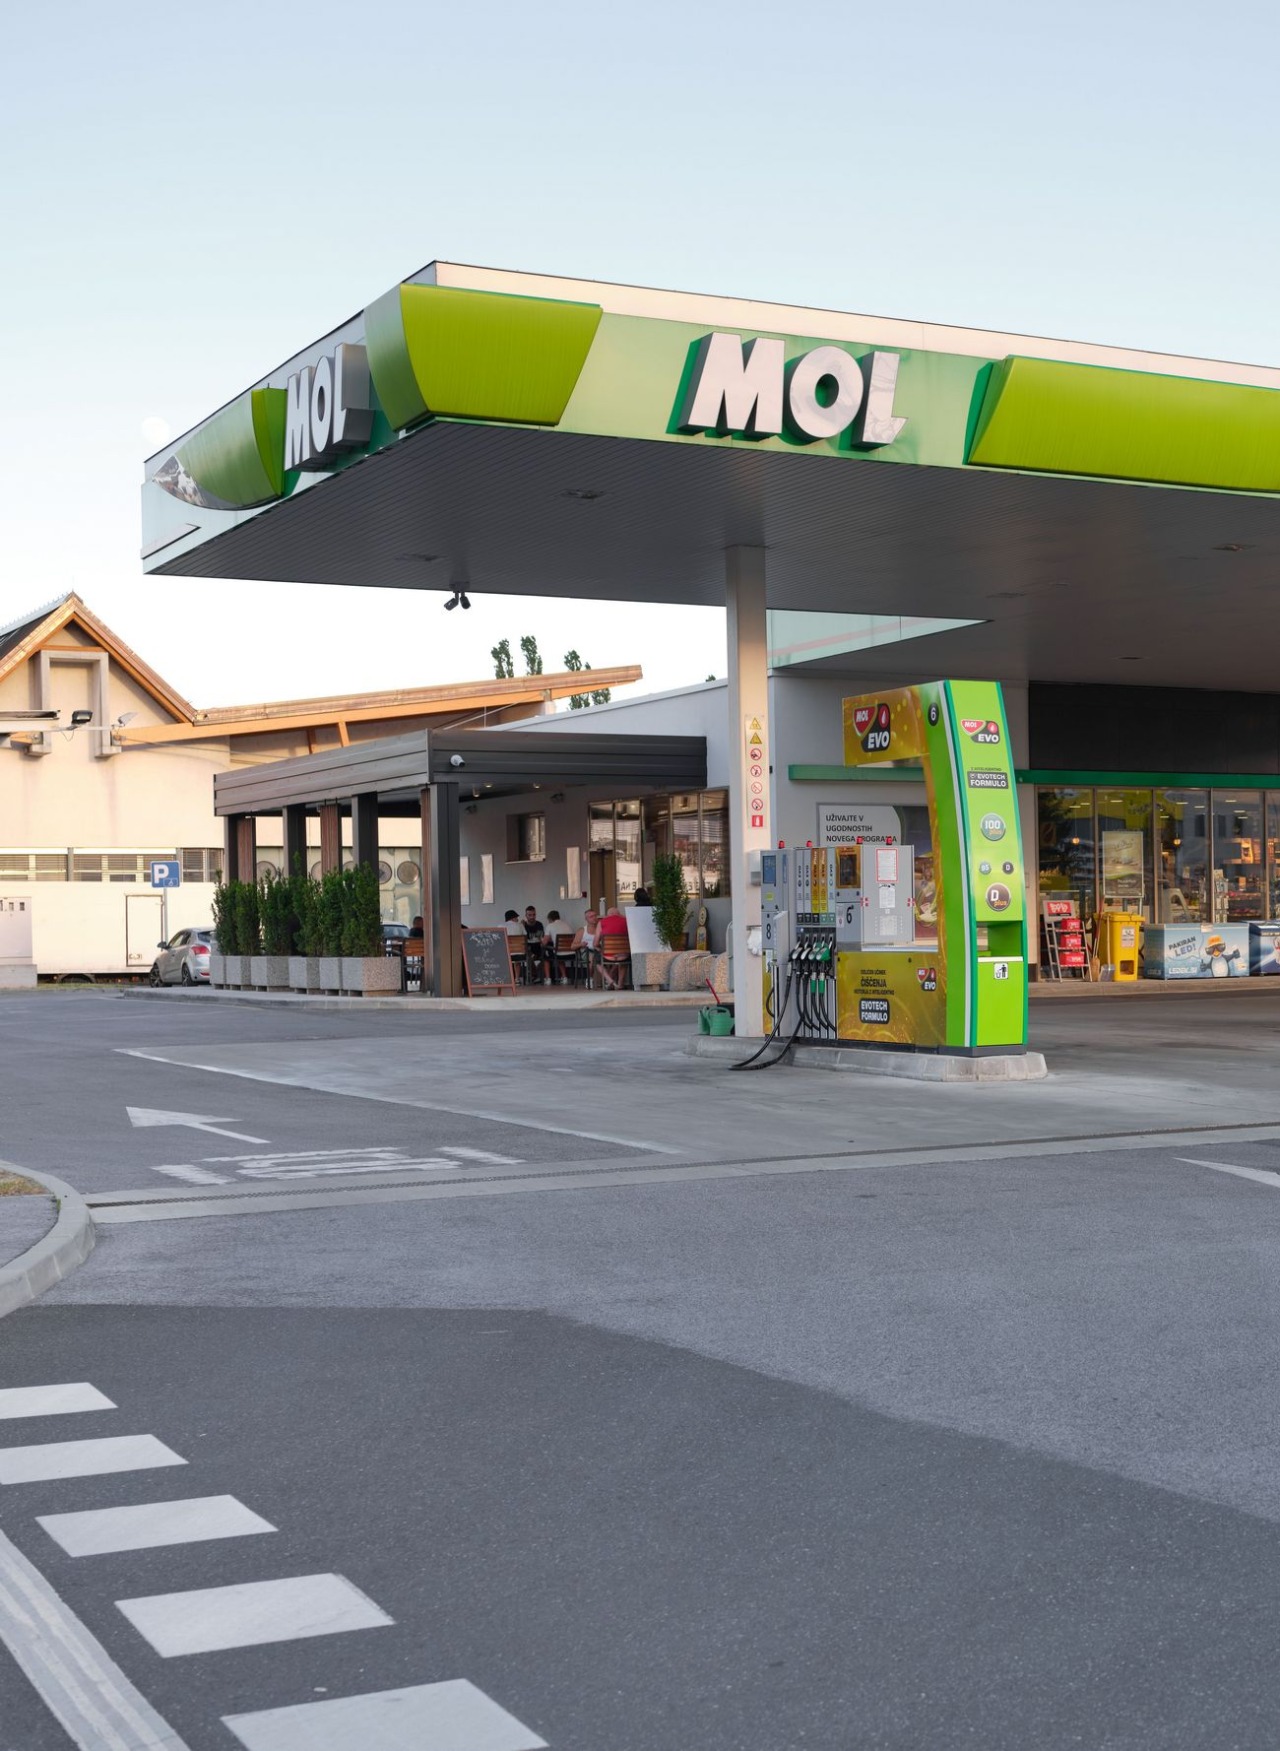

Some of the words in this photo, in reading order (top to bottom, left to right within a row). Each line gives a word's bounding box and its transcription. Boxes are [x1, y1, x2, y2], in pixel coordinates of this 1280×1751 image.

[684, 332, 908, 447] MOL
[284, 342, 362, 471] MOL
[856, 710, 868, 722] MOL
[930, 708, 936, 718] 6
[868, 732, 890, 749] EVO
[978, 734, 999, 743] EVO
[970, 780, 1007, 788] FORMULO
[826, 813, 857, 822] UŽIVAJTE
[985, 820, 1001, 830] 100
[154, 864, 169, 884] P
[990, 890, 999, 901] D
[846, 906, 852, 924] 6
[766, 923, 771, 940] 8
[1168, 936, 1196, 950] PAKIRAN
[1174, 944, 1196, 956] LED!
[861, 976, 887, 987] ČIŠČENJA
[924, 982, 936, 990] EVO
[861, 1001, 887, 1010] EVOTECH
[861, 1012, 887, 1021] FORMULO
